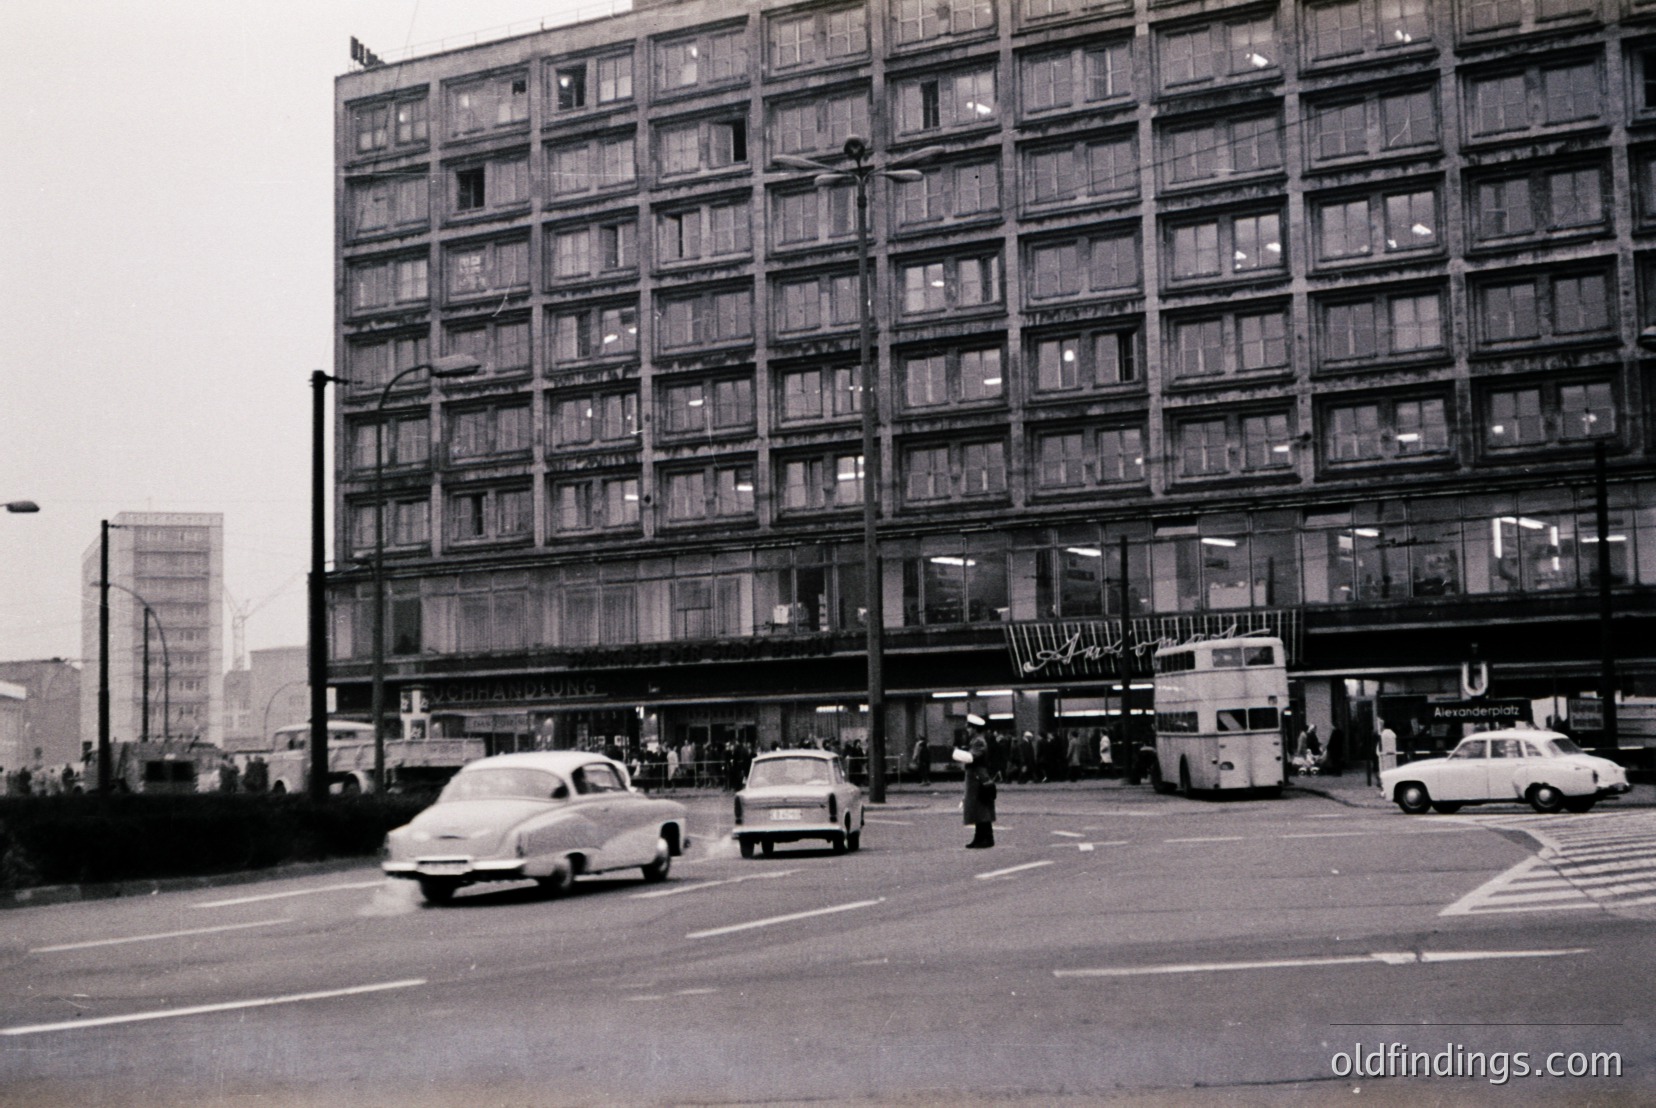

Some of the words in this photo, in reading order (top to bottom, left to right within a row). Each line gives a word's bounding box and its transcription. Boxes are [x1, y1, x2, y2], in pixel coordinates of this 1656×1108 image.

[668, 644, 703, 663] DER
[1462, 660, 1488, 696] U
[429, 677, 597, 703] UCHHANDLUNG
[1434, 705, 1520, 718] Alexanderplatz
